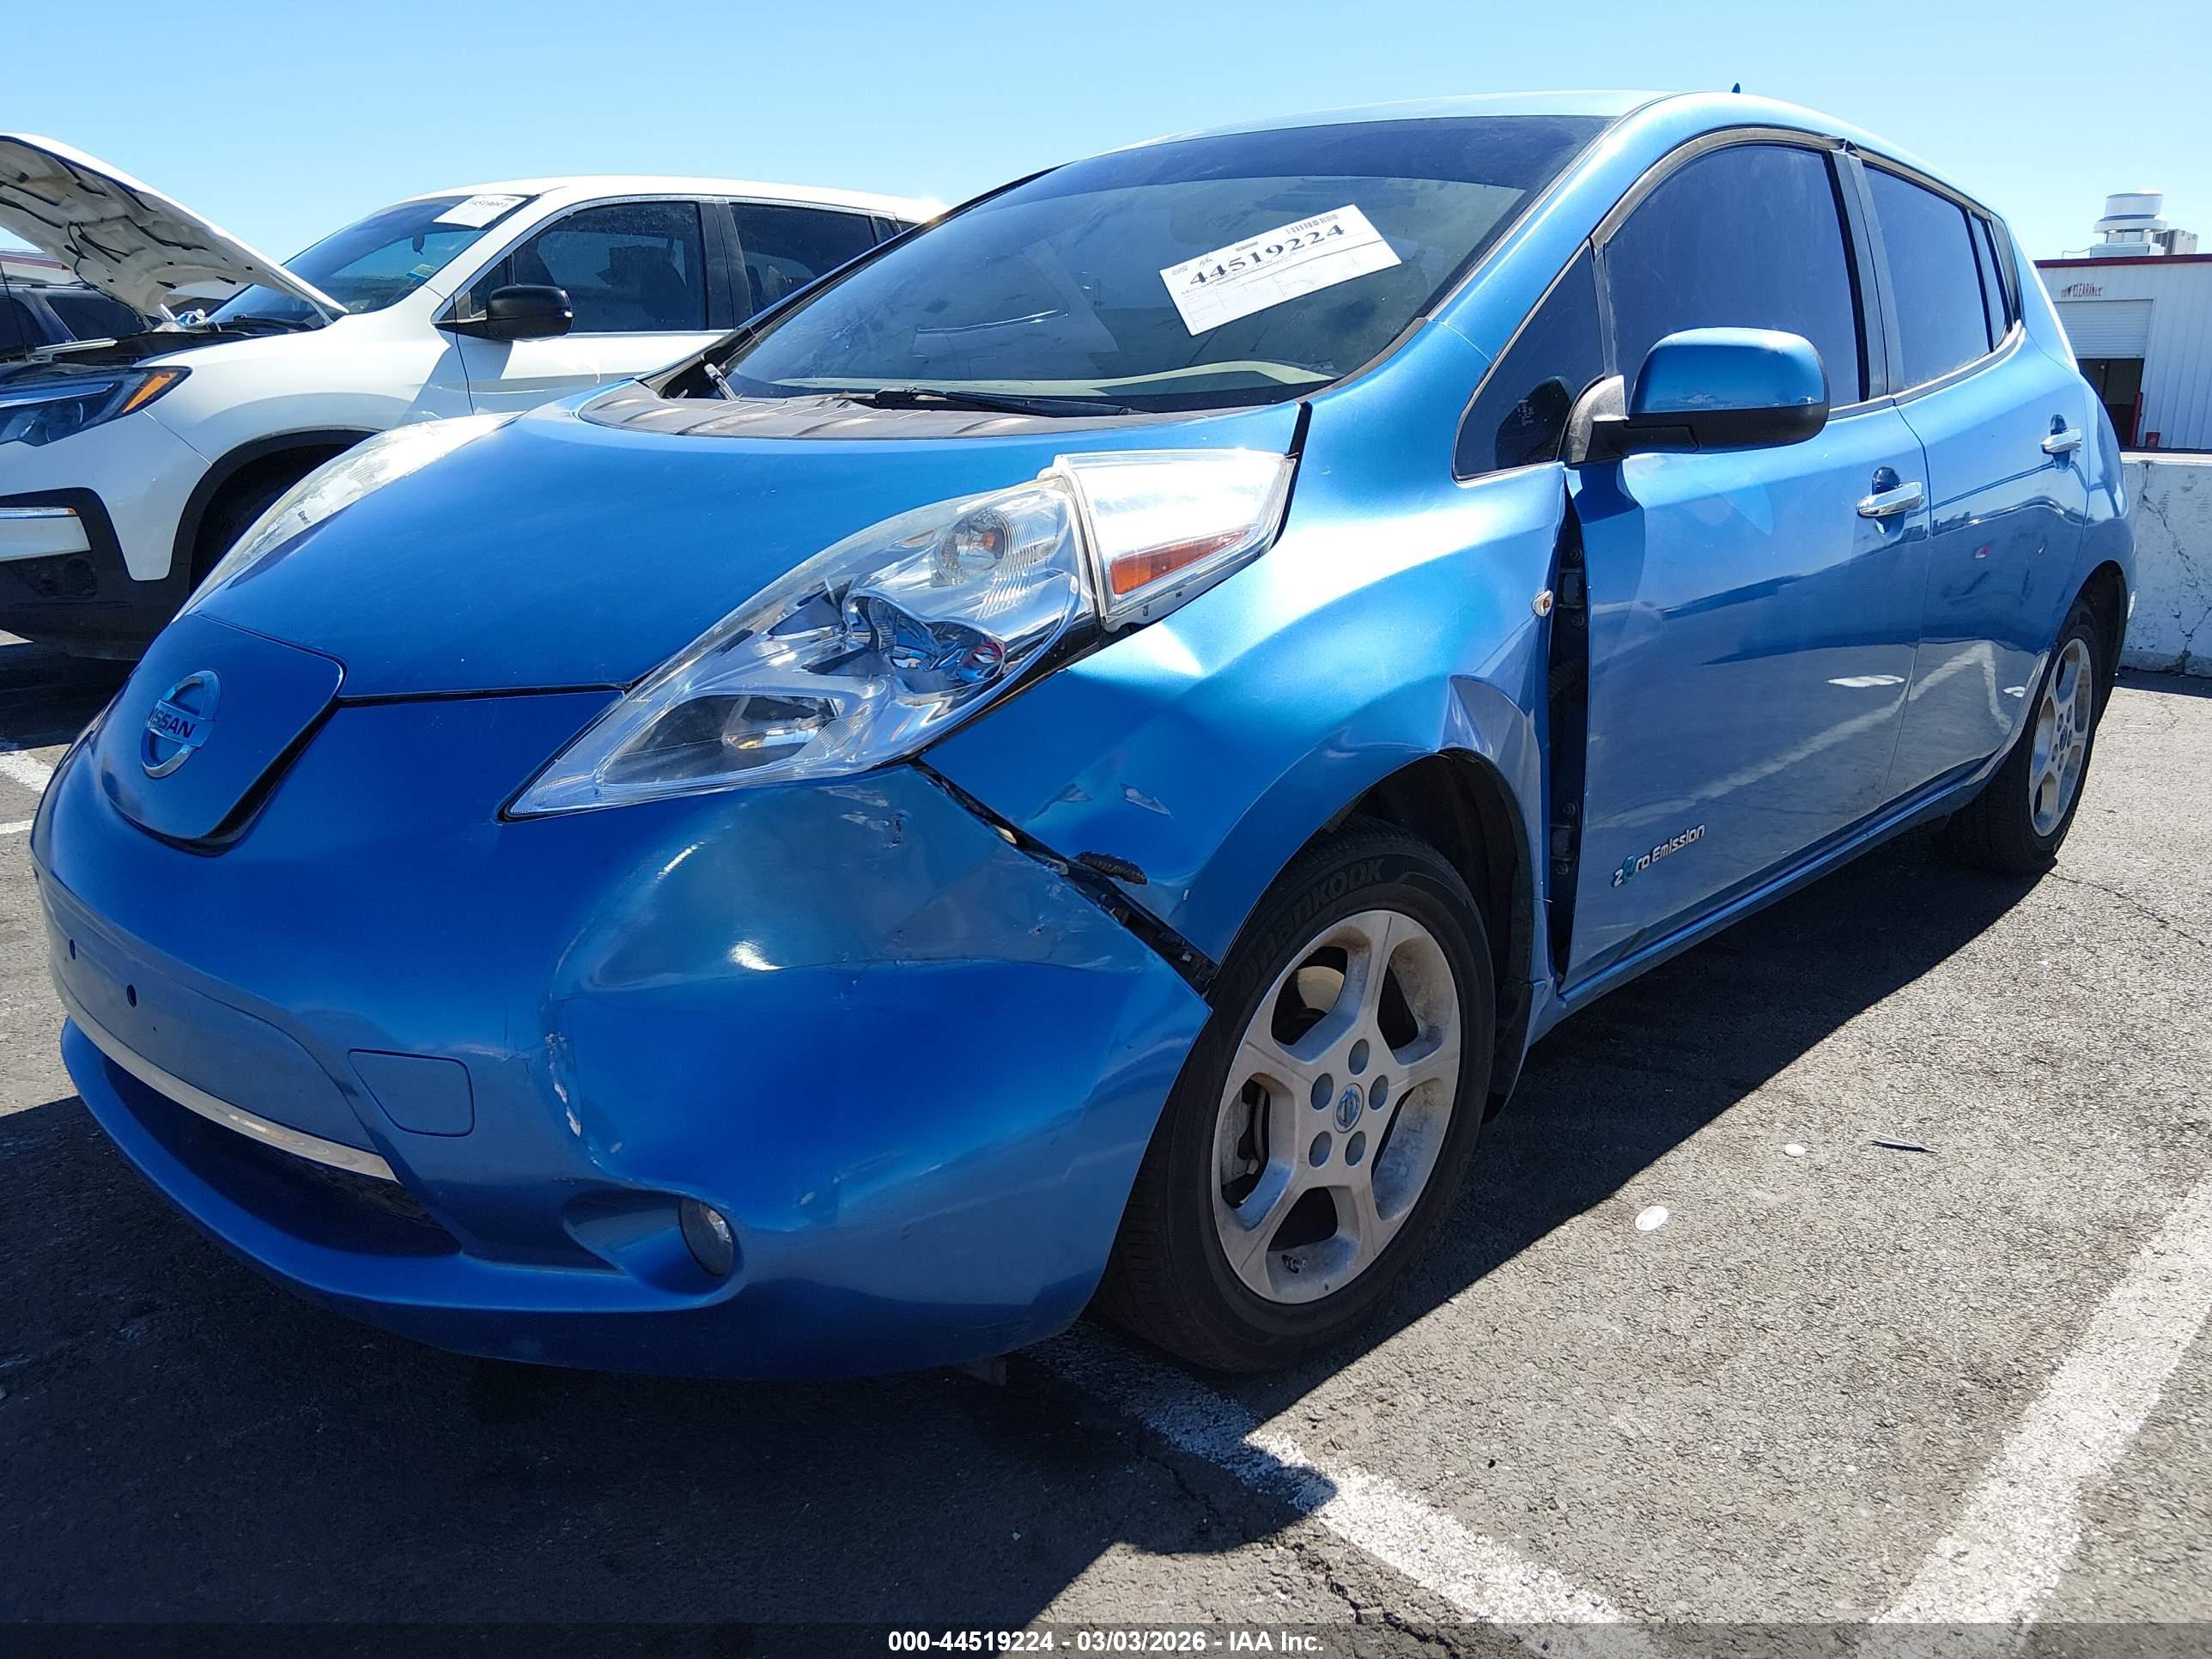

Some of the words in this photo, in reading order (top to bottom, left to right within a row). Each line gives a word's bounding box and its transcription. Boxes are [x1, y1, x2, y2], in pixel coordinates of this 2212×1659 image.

[1189, 224, 1345, 285] 44519224
[149, 706, 197, 738] ISSAN
[1651, 824, 1705, 863] Emission
